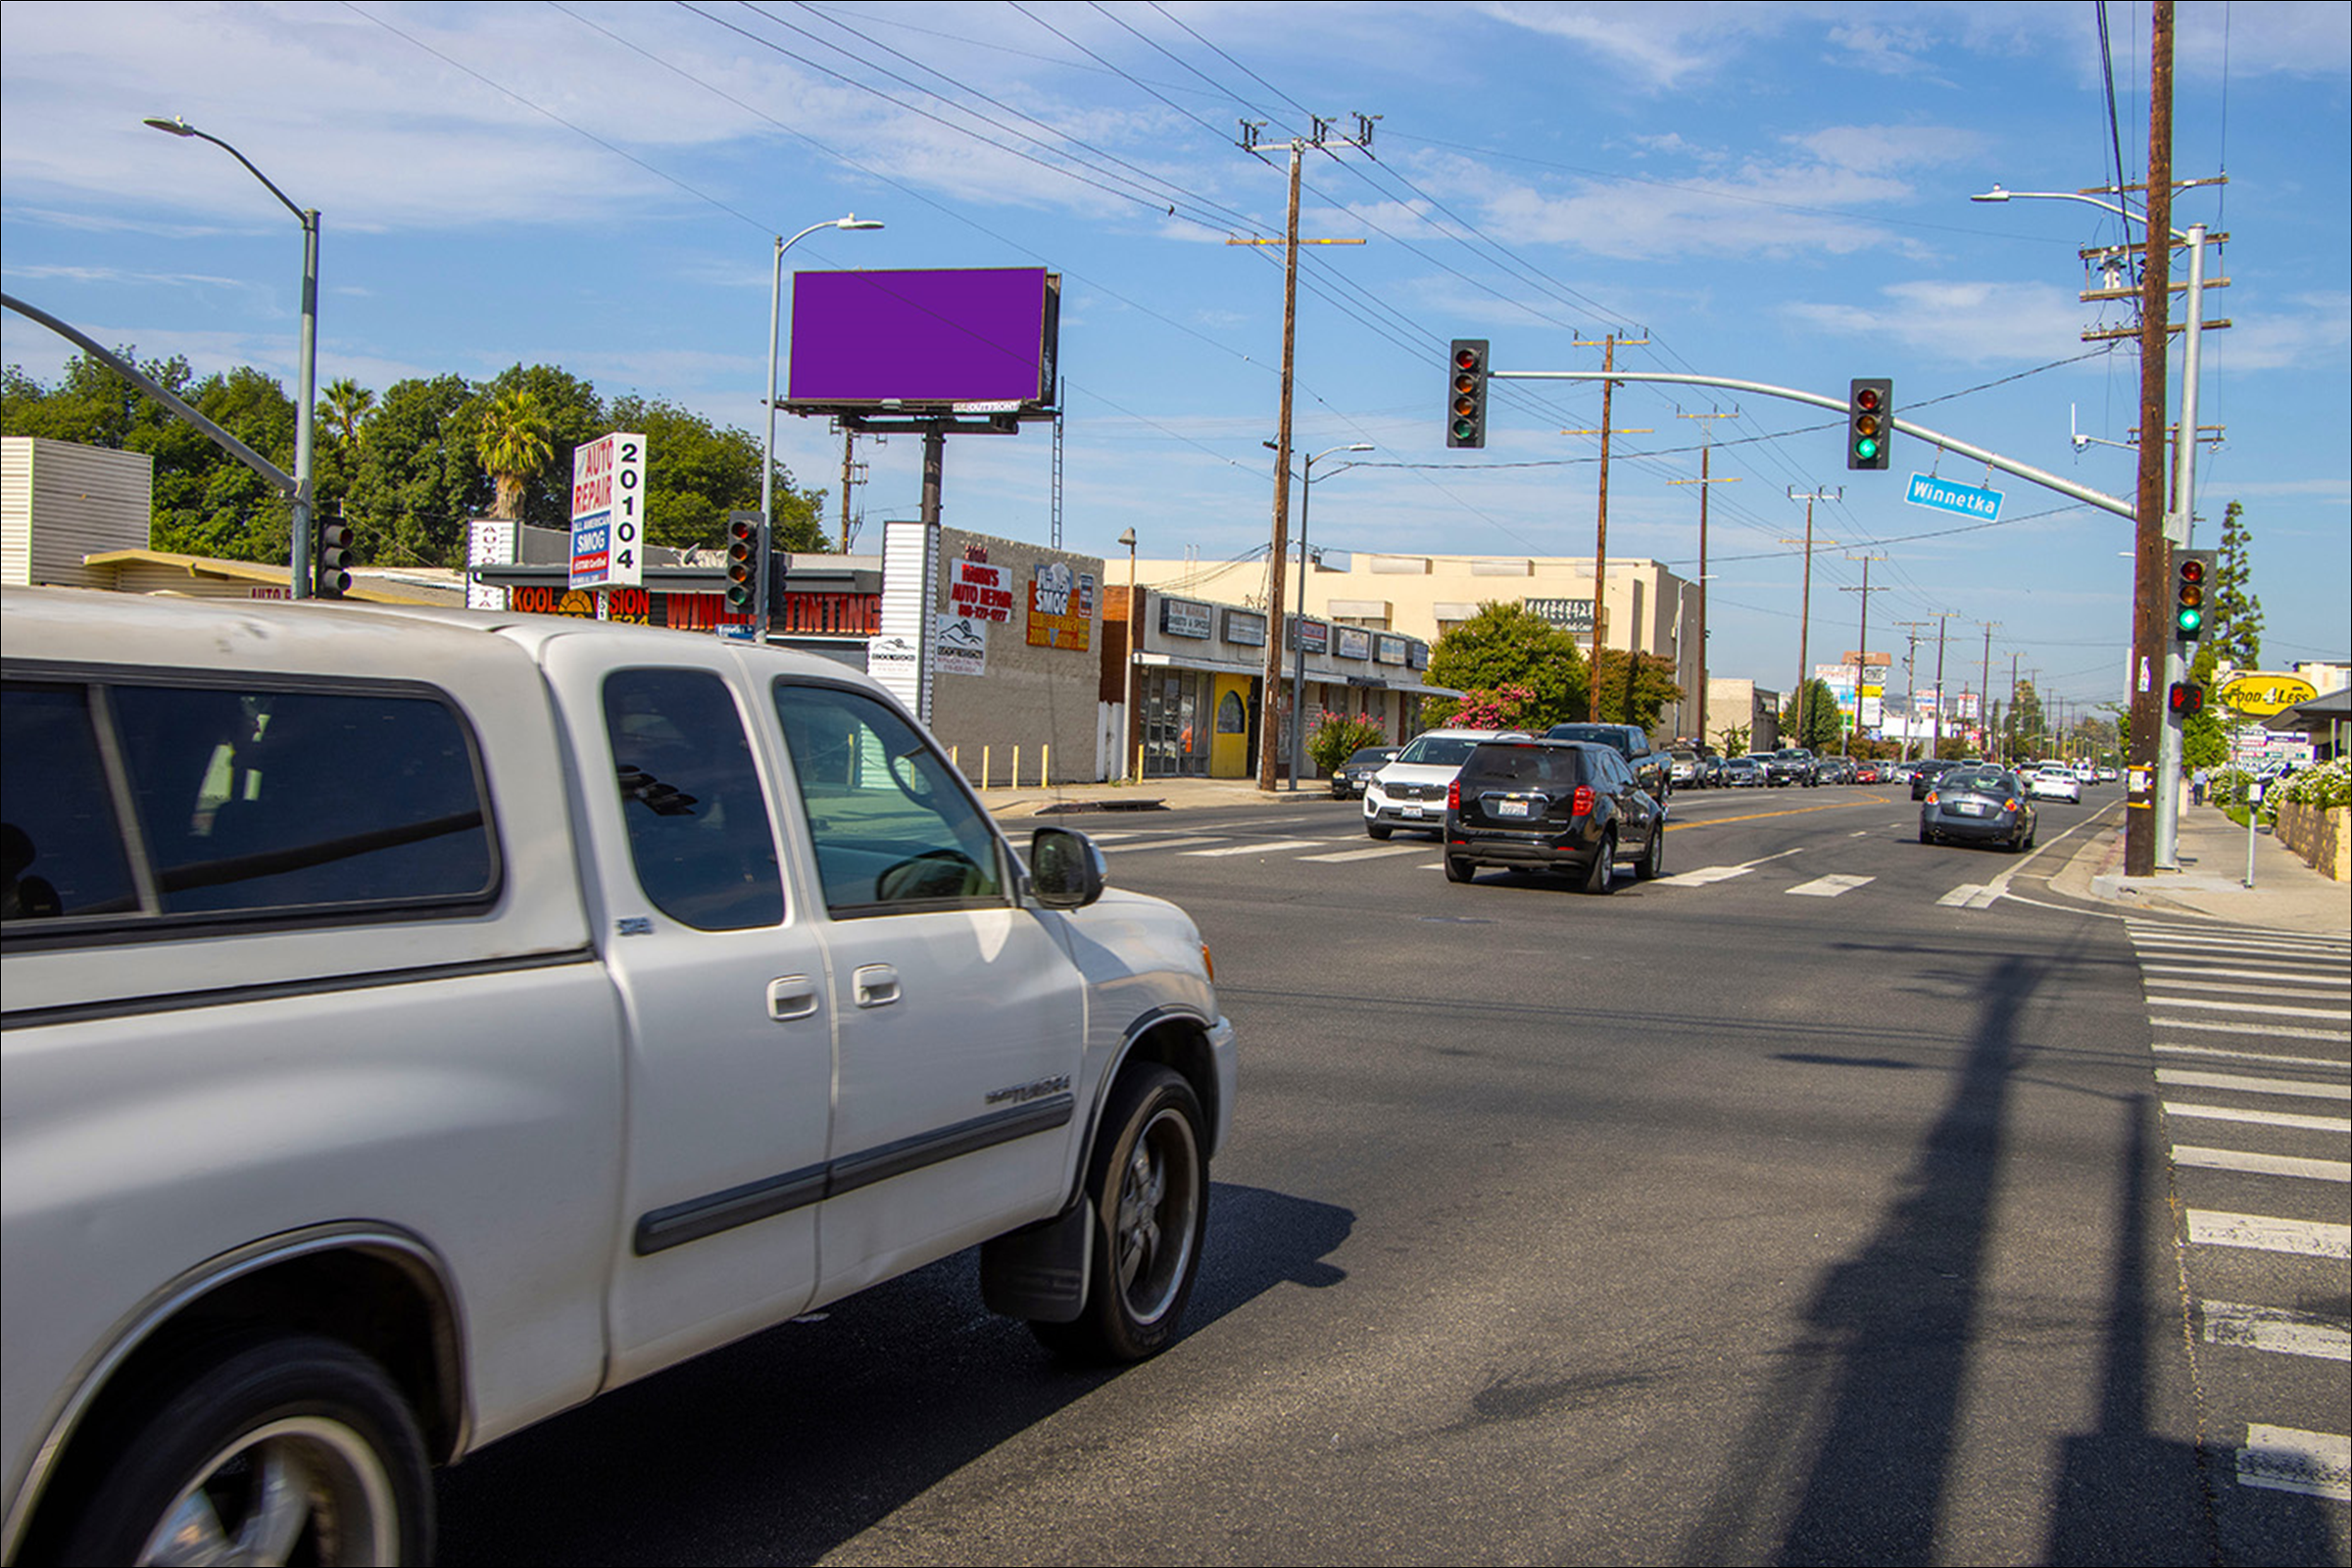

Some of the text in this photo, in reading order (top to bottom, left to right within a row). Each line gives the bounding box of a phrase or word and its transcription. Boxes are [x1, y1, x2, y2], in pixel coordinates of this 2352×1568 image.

[585, 439, 613, 478] AUTO
[574, 475, 612, 514] REPAIR
[616, 443, 638, 568] 20104
[1914, 480, 1995, 514] Winnetka
[576, 529, 605, 553] SMOG
[513, 586, 557, 612] KOOL
[952, 583, 1012, 610] AUTO REPAIR
[1035, 590, 1067, 615] SMOG
[784, 592, 881, 635] TINTING
[2229, 687, 2310, 705] FOOD 4 LESS
